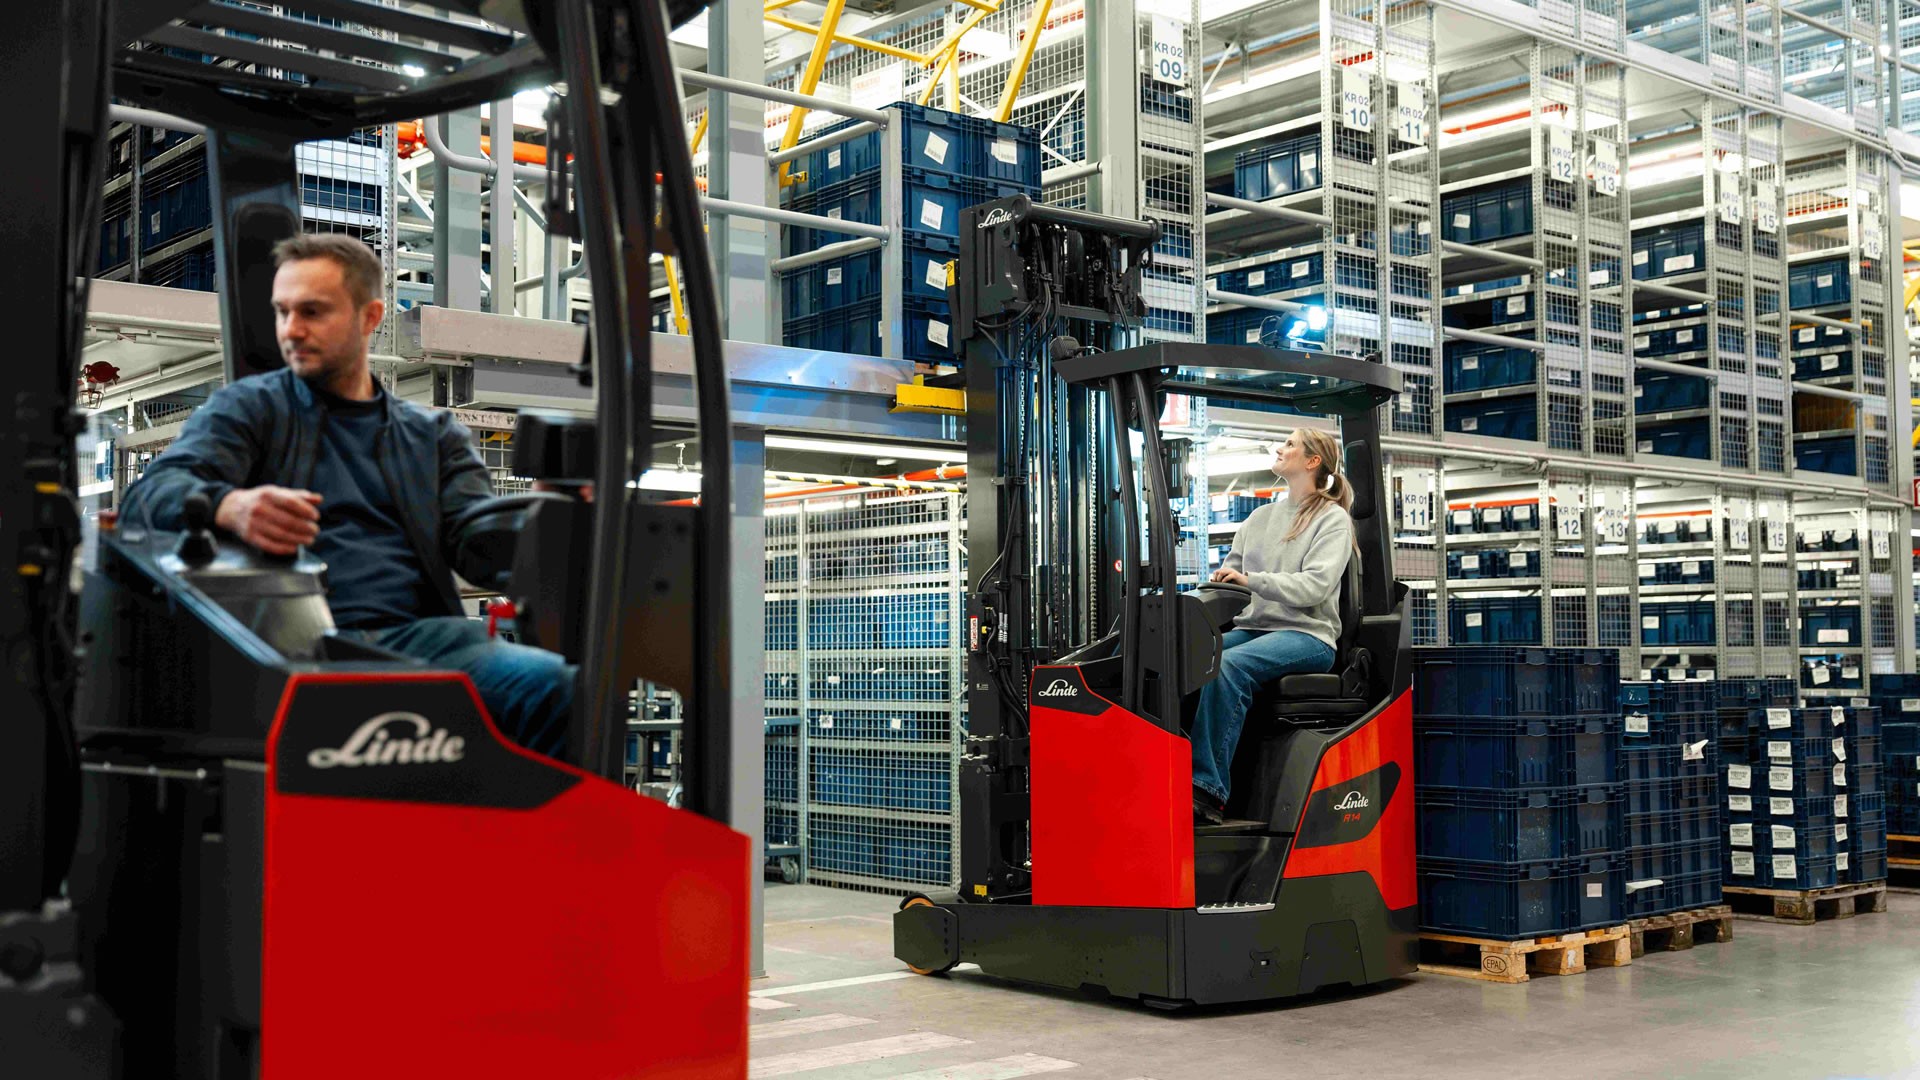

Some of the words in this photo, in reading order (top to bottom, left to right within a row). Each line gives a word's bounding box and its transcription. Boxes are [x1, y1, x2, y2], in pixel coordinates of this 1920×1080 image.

[1154, 41, 1169, 54] KR
[1170, 46, 1183, 58] 02
[1344, 92, 1357, 103] KR
[1358, 95, 1369, 106] 02
[1400, 106, 1411, 117] KR
[1412, 109, 1423, 120] 02
[977, 207, 1012, 229] Linde
[1404, 494, 1417, 504] KR
[1418, 495, 1427, 505] 01
[1558, 506, 1569, 516] KR
[1038, 678, 1078, 697] Linde
[307, 711, 465, 769] Linde
[1333, 790, 1369, 811] Linde
[1486, 959, 1503, 971] EPAL
